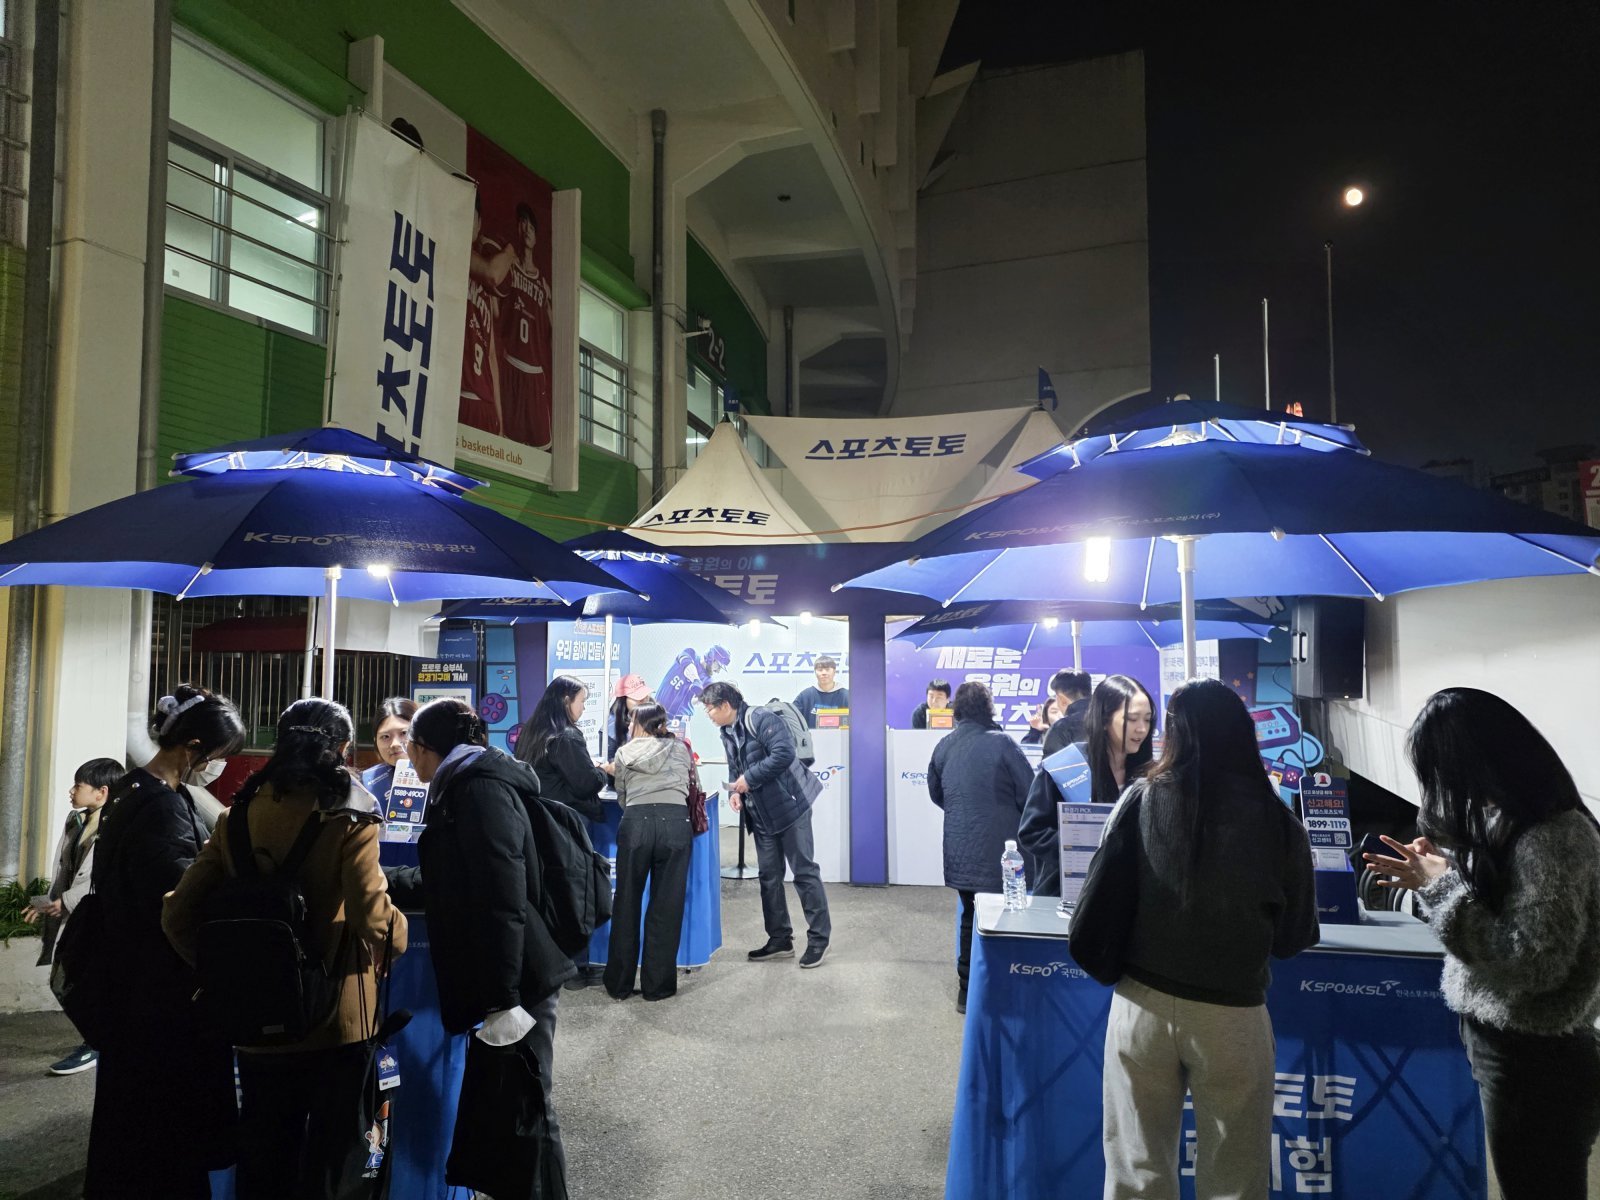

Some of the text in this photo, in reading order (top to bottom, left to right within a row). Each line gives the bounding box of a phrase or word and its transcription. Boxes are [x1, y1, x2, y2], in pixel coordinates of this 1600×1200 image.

[519, 318, 529, 344] 0
[461, 435, 523, 465] basketball club
[805, 434, 967, 460] 스포츠토토
[640, 507, 771, 528] 스포츠토토
[243, 532, 333, 546] KSPO
[742, 652, 849, 674] 스포츠
[936, 646, 1024, 669] 새로운
[1009, 963, 1051, 977] KSPO
[1300, 980, 1387, 996] KSPO&KSL
